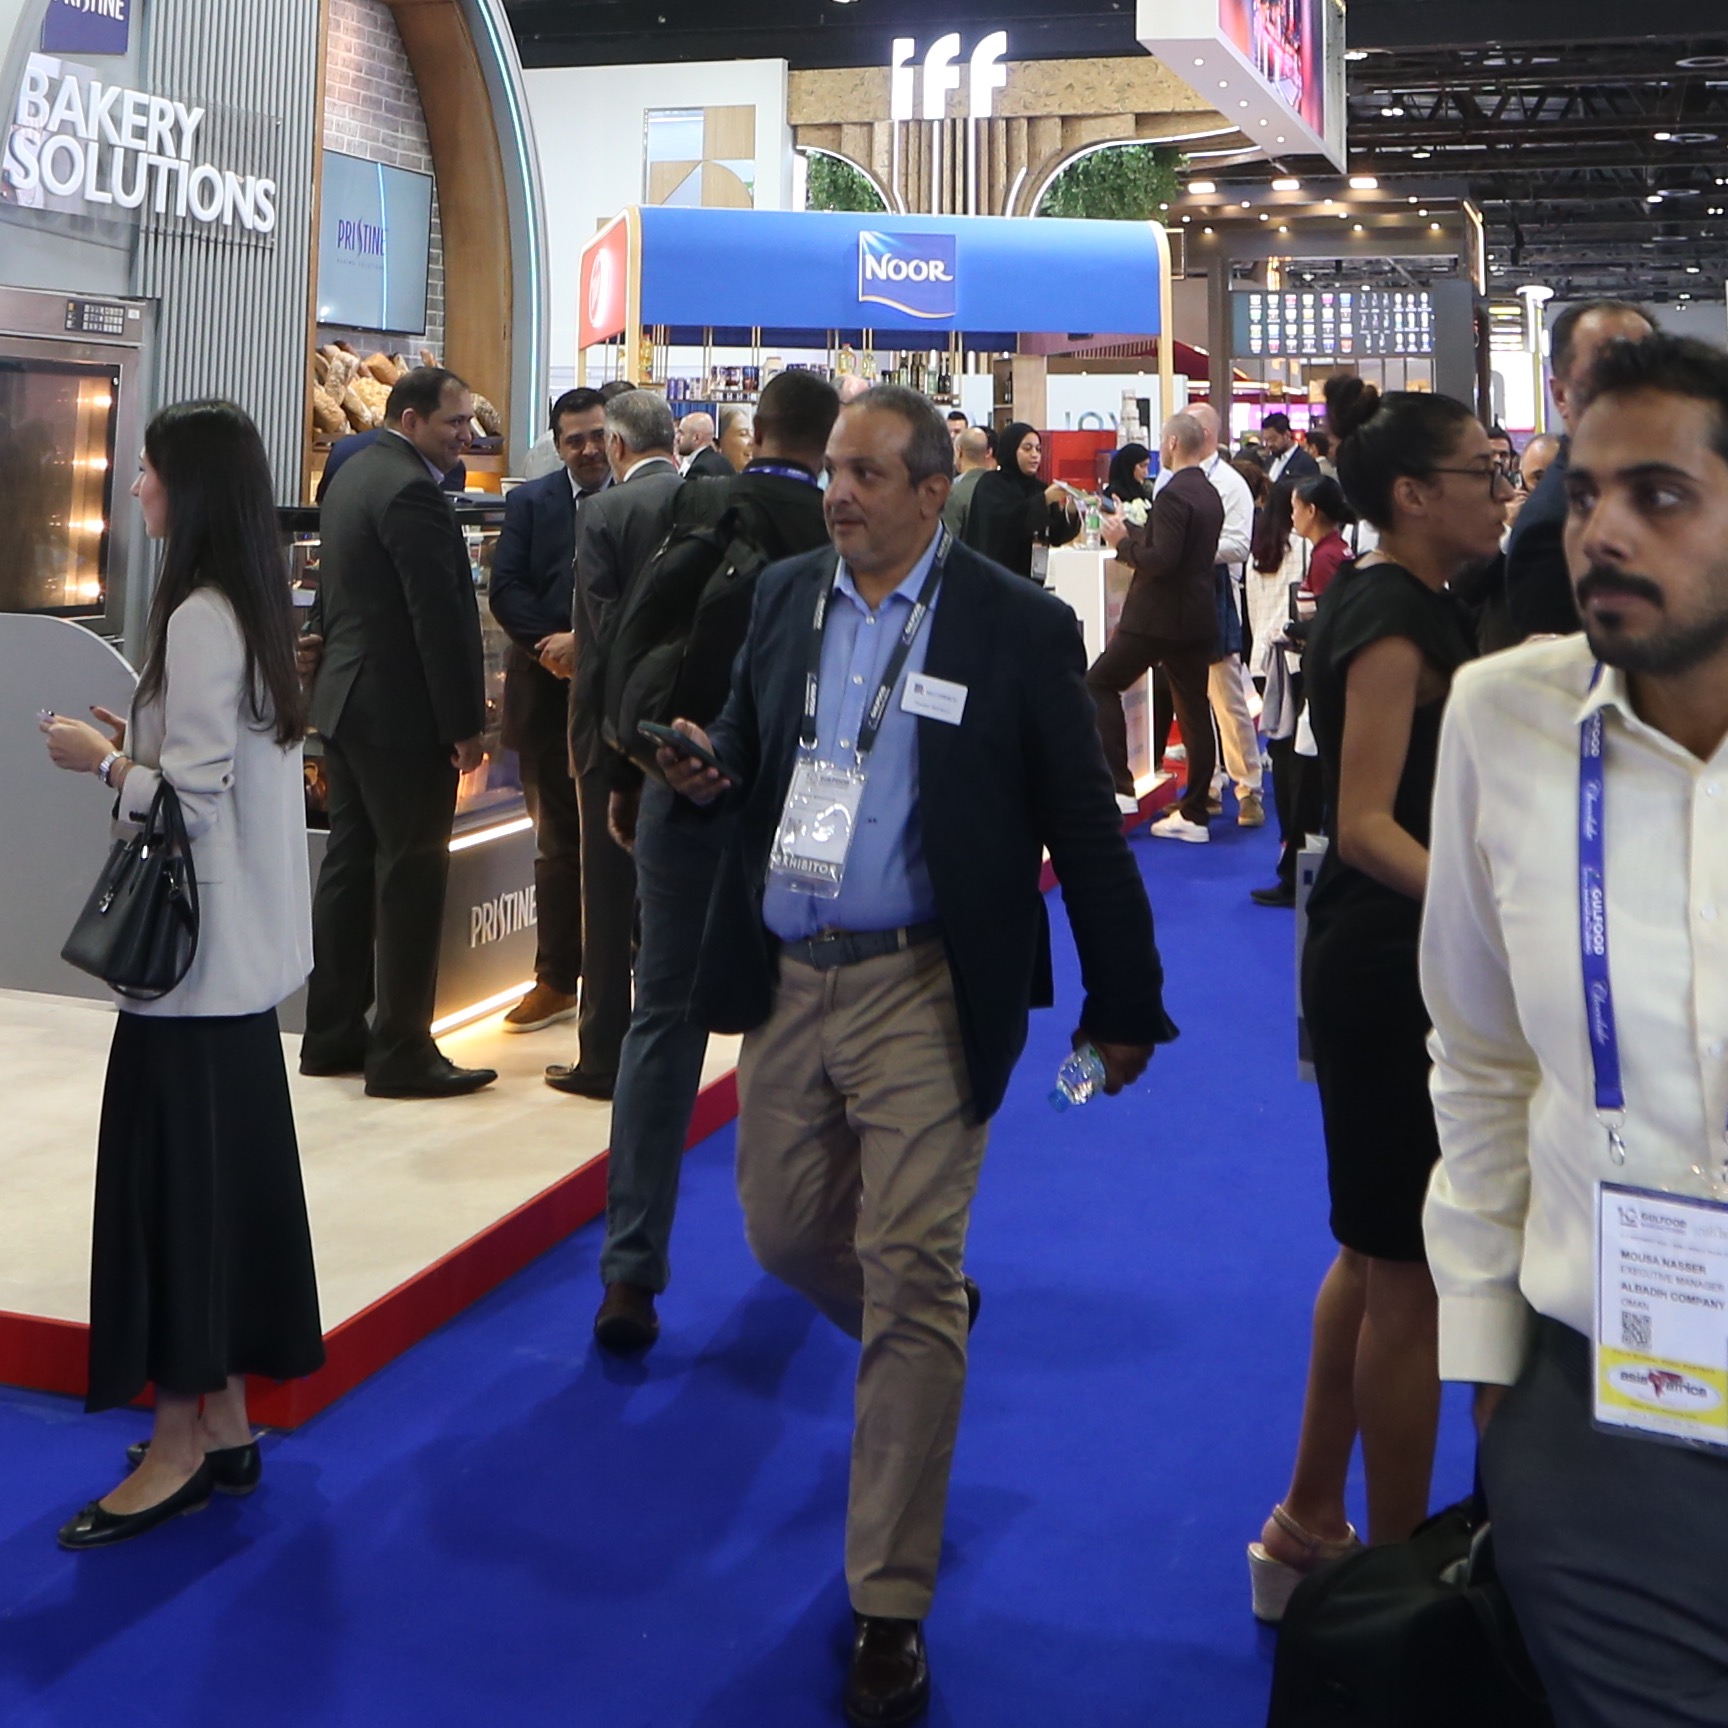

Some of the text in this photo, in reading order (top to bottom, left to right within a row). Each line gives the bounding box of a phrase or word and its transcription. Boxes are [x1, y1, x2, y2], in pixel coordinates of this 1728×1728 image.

[17, 65, 205, 160] BAKERY
[891, 30, 1009, 120] iff
[7, 132, 276, 233] SOLUTIONS
[471, 884, 538, 949] PRISTINE
[1591, 888, 1605, 956] GULFOOD
[1670, 1292, 1727, 1311] COMPANY
